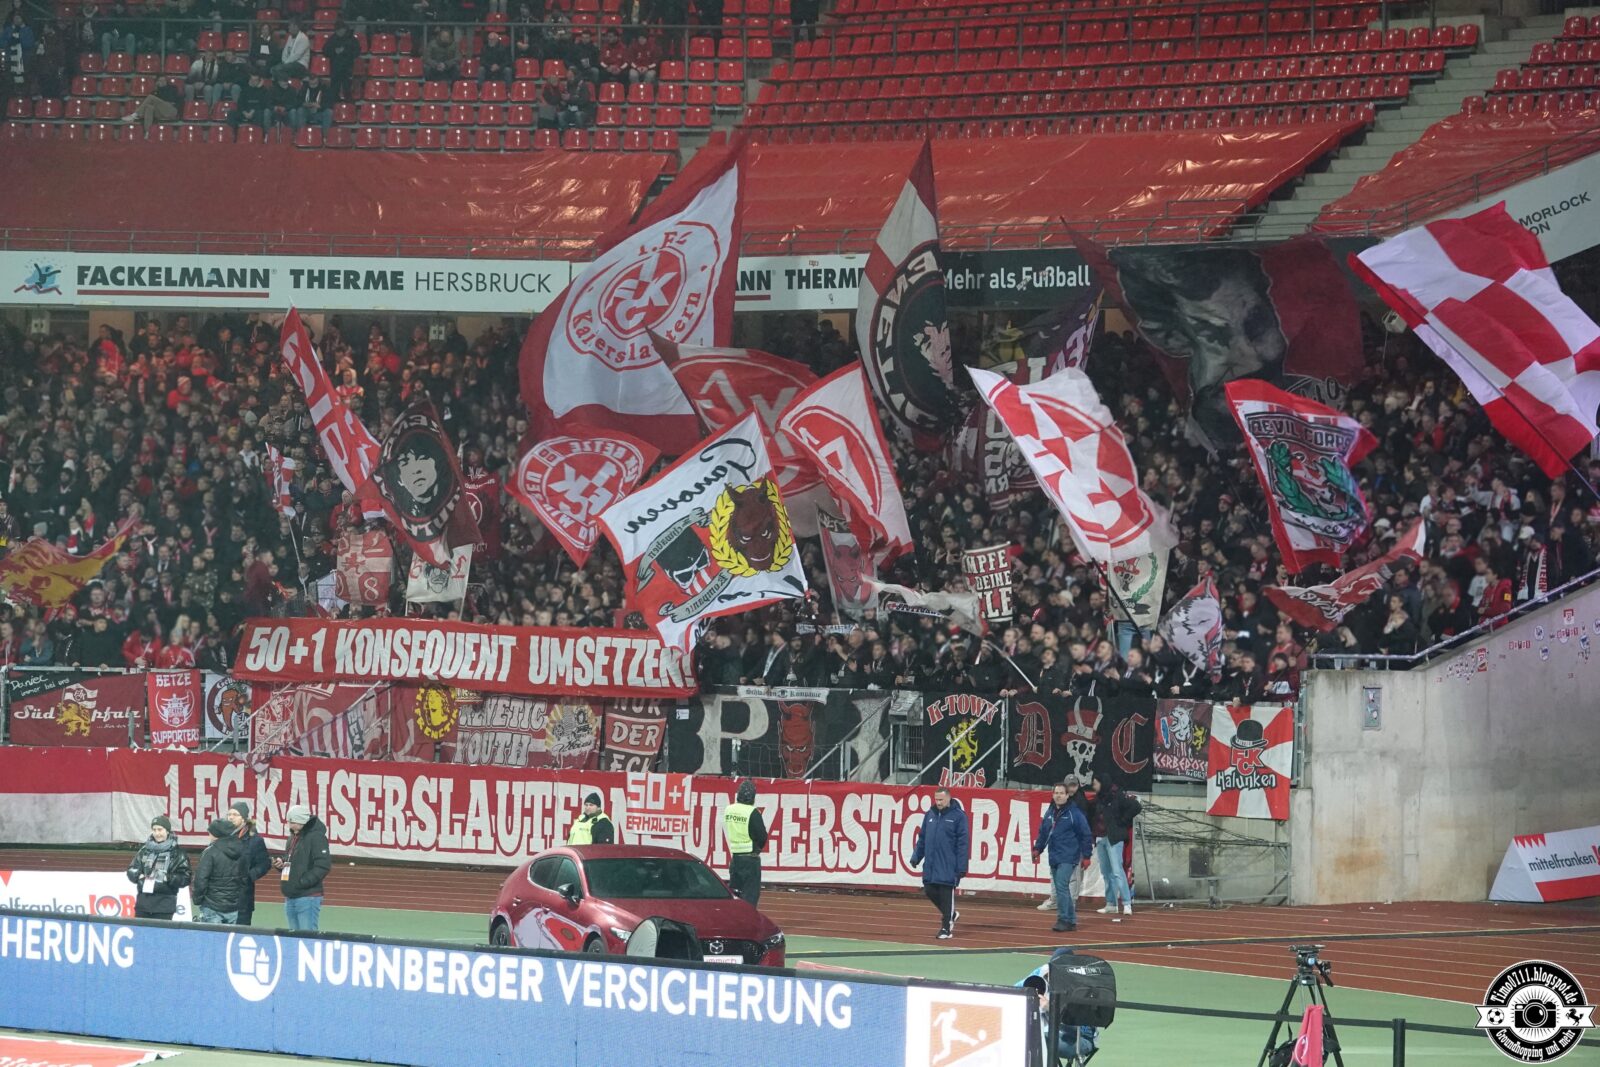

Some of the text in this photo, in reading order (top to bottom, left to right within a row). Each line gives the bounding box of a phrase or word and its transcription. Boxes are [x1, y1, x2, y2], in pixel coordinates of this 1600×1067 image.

[1519, 191, 1592, 226] MORLOCK
[77, 265, 551, 293] FACKELMANN THERME HERSBRUCK
[989, 267, 1016, 289] als
[1021, 264, 1091, 289] Fußball
[976, 570, 1012, 590] DEINE
[246, 626, 327, 672] 50+1
[335, 628, 516, 681] KONSEQUENT
[156, 672, 192, 687] BETZE
[13, 704, 56, 720] Süd
[927, 693, 998, 726] K-TOWN
[611, 721, 661, 748] DER
[454, 731, 532, 766] YOUTH
[626, 772, 693, 812] 50+1
[1217, 770, 1278, 791] Halunken
[626, 814, 690, 833] ERHALTEN
[1528, 851, 1597, 872] mittelfranken
[1, 917, 134, 969] HERUNG
[297, 938, 852, 1030] NÜRNBERGER VERSICHERUNG
